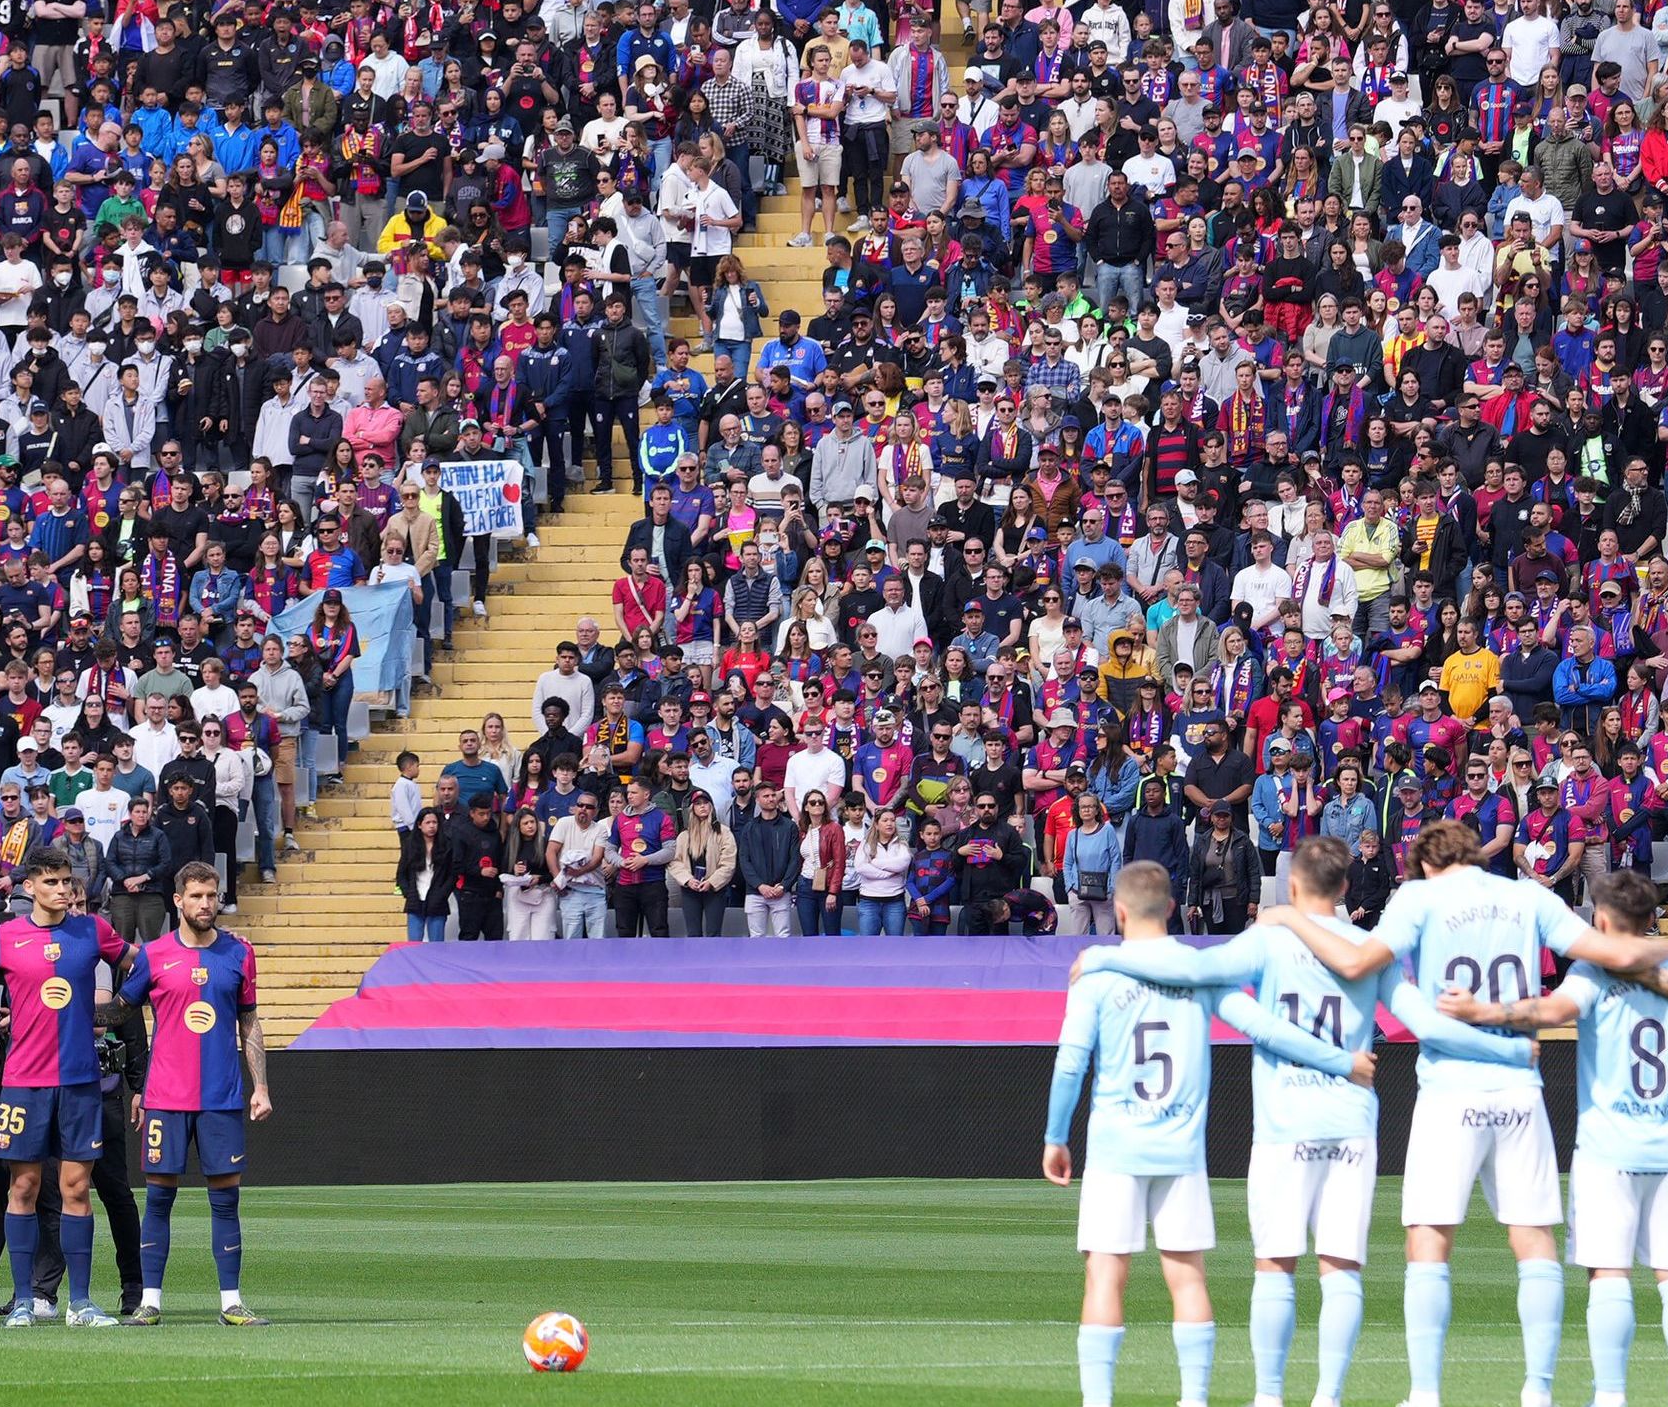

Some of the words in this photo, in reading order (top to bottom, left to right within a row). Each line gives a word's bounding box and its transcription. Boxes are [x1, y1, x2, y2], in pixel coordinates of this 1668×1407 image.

[476, 488, 502, 508] FAN
[1279, 991, 1344, 1050] 14
[1444, 953, 1529, 1032] 20
[1132, 1019, 1174, 1102] 5
[1630, 1017, 1667, 1100] 8
[146, 1119, 163, 1146] 5
[1293, 1140, 1365, 1165] Recalvi
